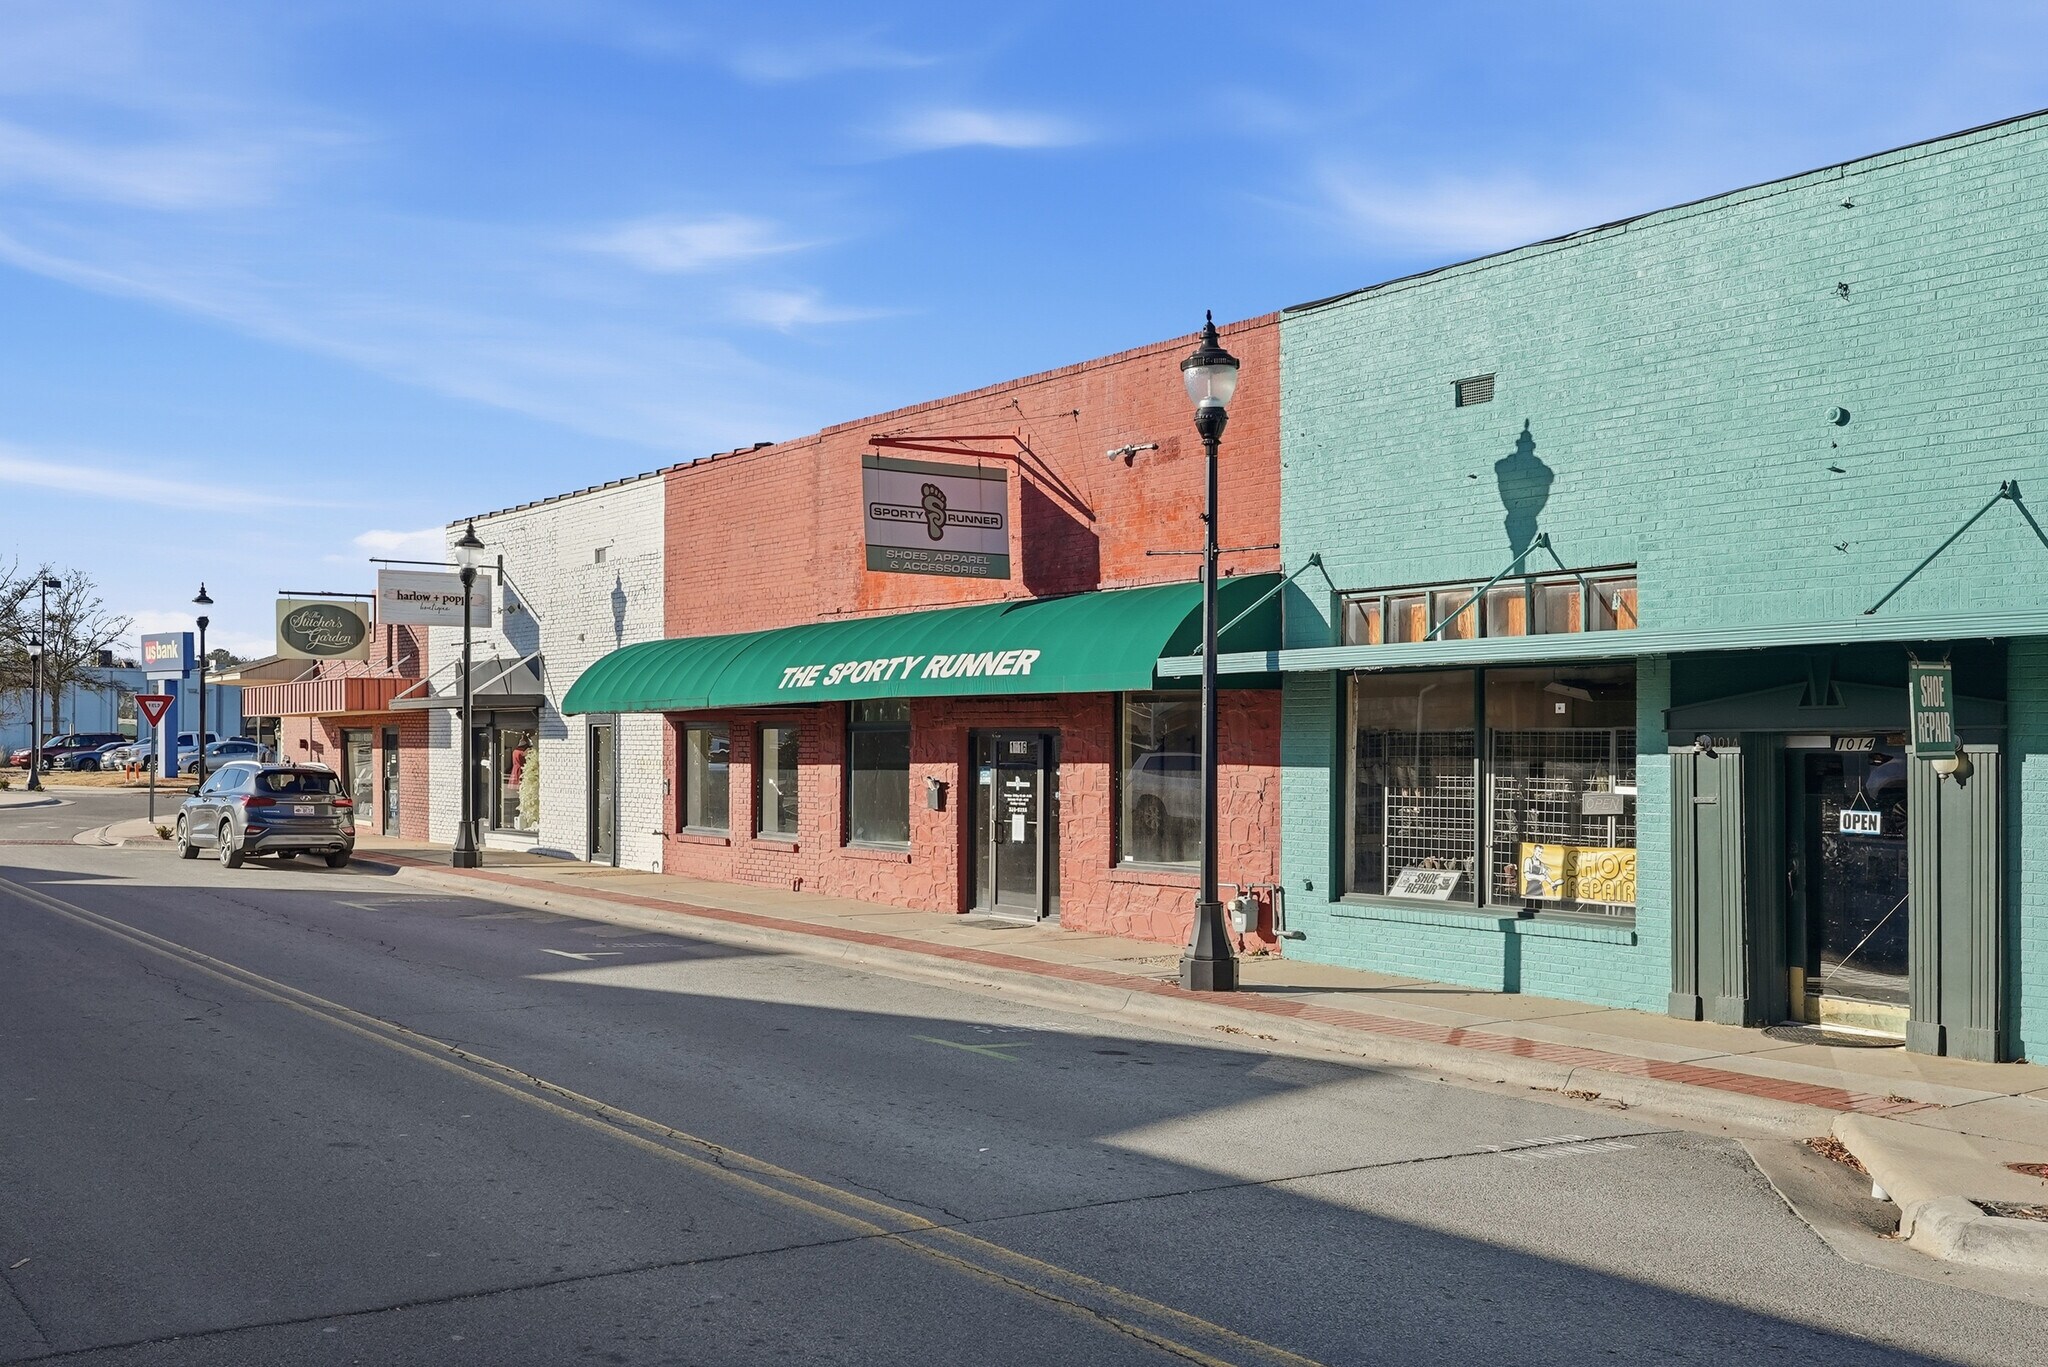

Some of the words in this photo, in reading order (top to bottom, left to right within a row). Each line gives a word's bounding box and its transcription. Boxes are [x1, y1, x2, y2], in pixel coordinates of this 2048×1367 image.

[873, 507, 924, 519] SPORTY
[948, 514, 999, 525] RUNNER
[886, 549, 931, 562] SHOES,
[934, 553, 991, 565] APPAREL
[890, 560, 900, 569] &
[903, 561, 987, 575] ACCESSORIES
[396, 590, 431, 602] harlow
[420, 602, 451, 614] boutique
[306, 628, 354, 650] Garden
[778, 664, 825, 689] THE
[823, 655, 925, 686] SPORTY
[921, 649, 1041, 679] RUNNER
[1920, 674, 1945, 708] SHOE
[1917, 711, 1952, 743] REPAIR
[1713, 736, 1738, 748] 1014
[1838, 738, 1873, 750] 1014
[1586, 797, 1620, 811] OPEN
[1842, 813, 1878, 831] OPEN
[1567, 849, 1636, 881] SHOE
[1415, 872, 1441, 884] SHOE
[1404, 883, 1438, 895] REPAIR
[1566, 876, 1636, 903] REPAIR
